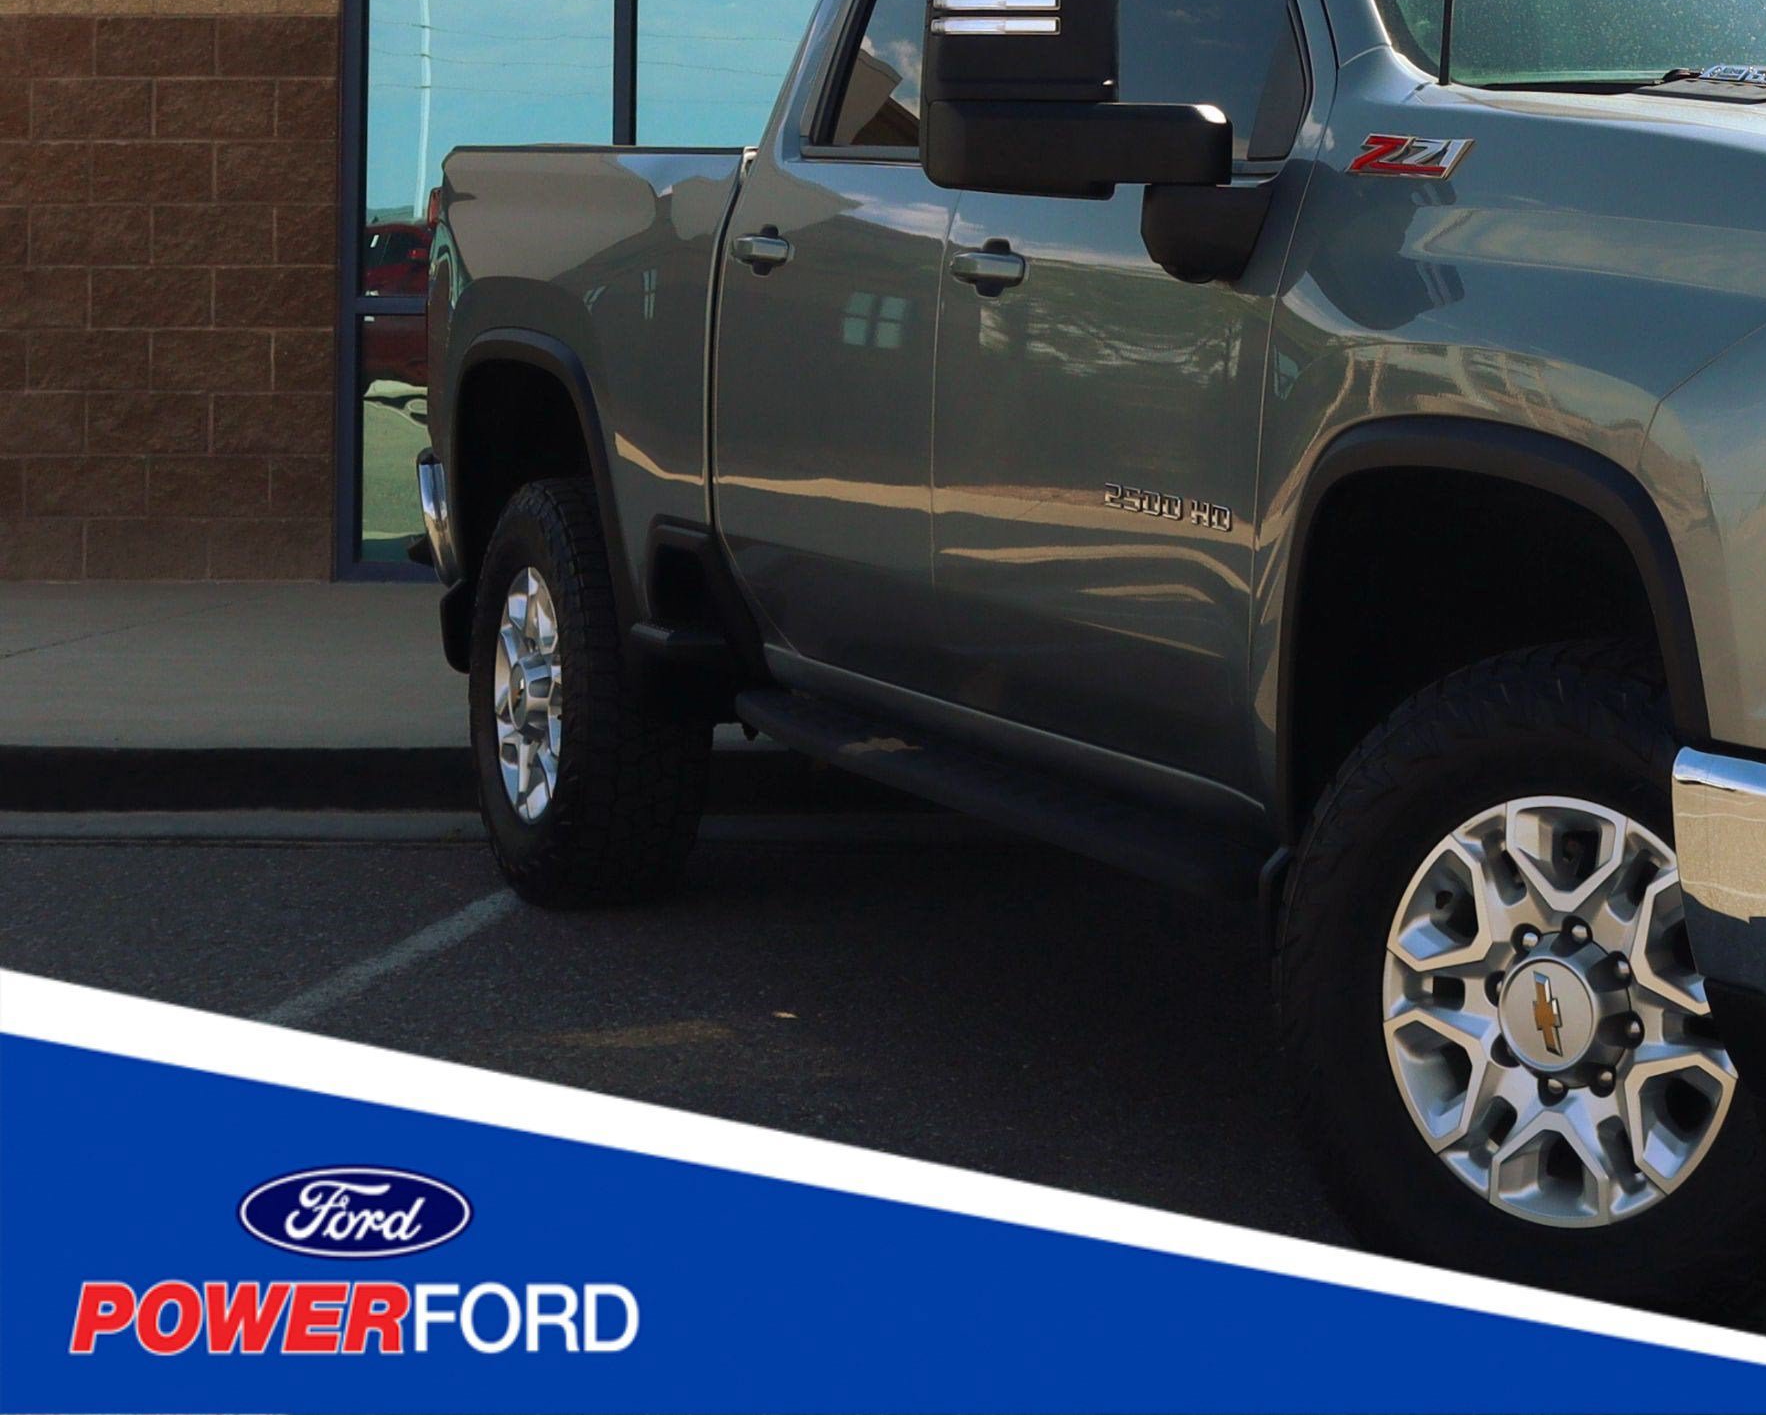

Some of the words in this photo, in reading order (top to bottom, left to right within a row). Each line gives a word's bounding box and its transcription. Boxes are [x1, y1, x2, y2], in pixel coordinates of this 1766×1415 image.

[1344, 133, 1475, 180] Z71
[1104, 482, 1184, 521] 2500
[1190, 499, 1233, 532] HD
